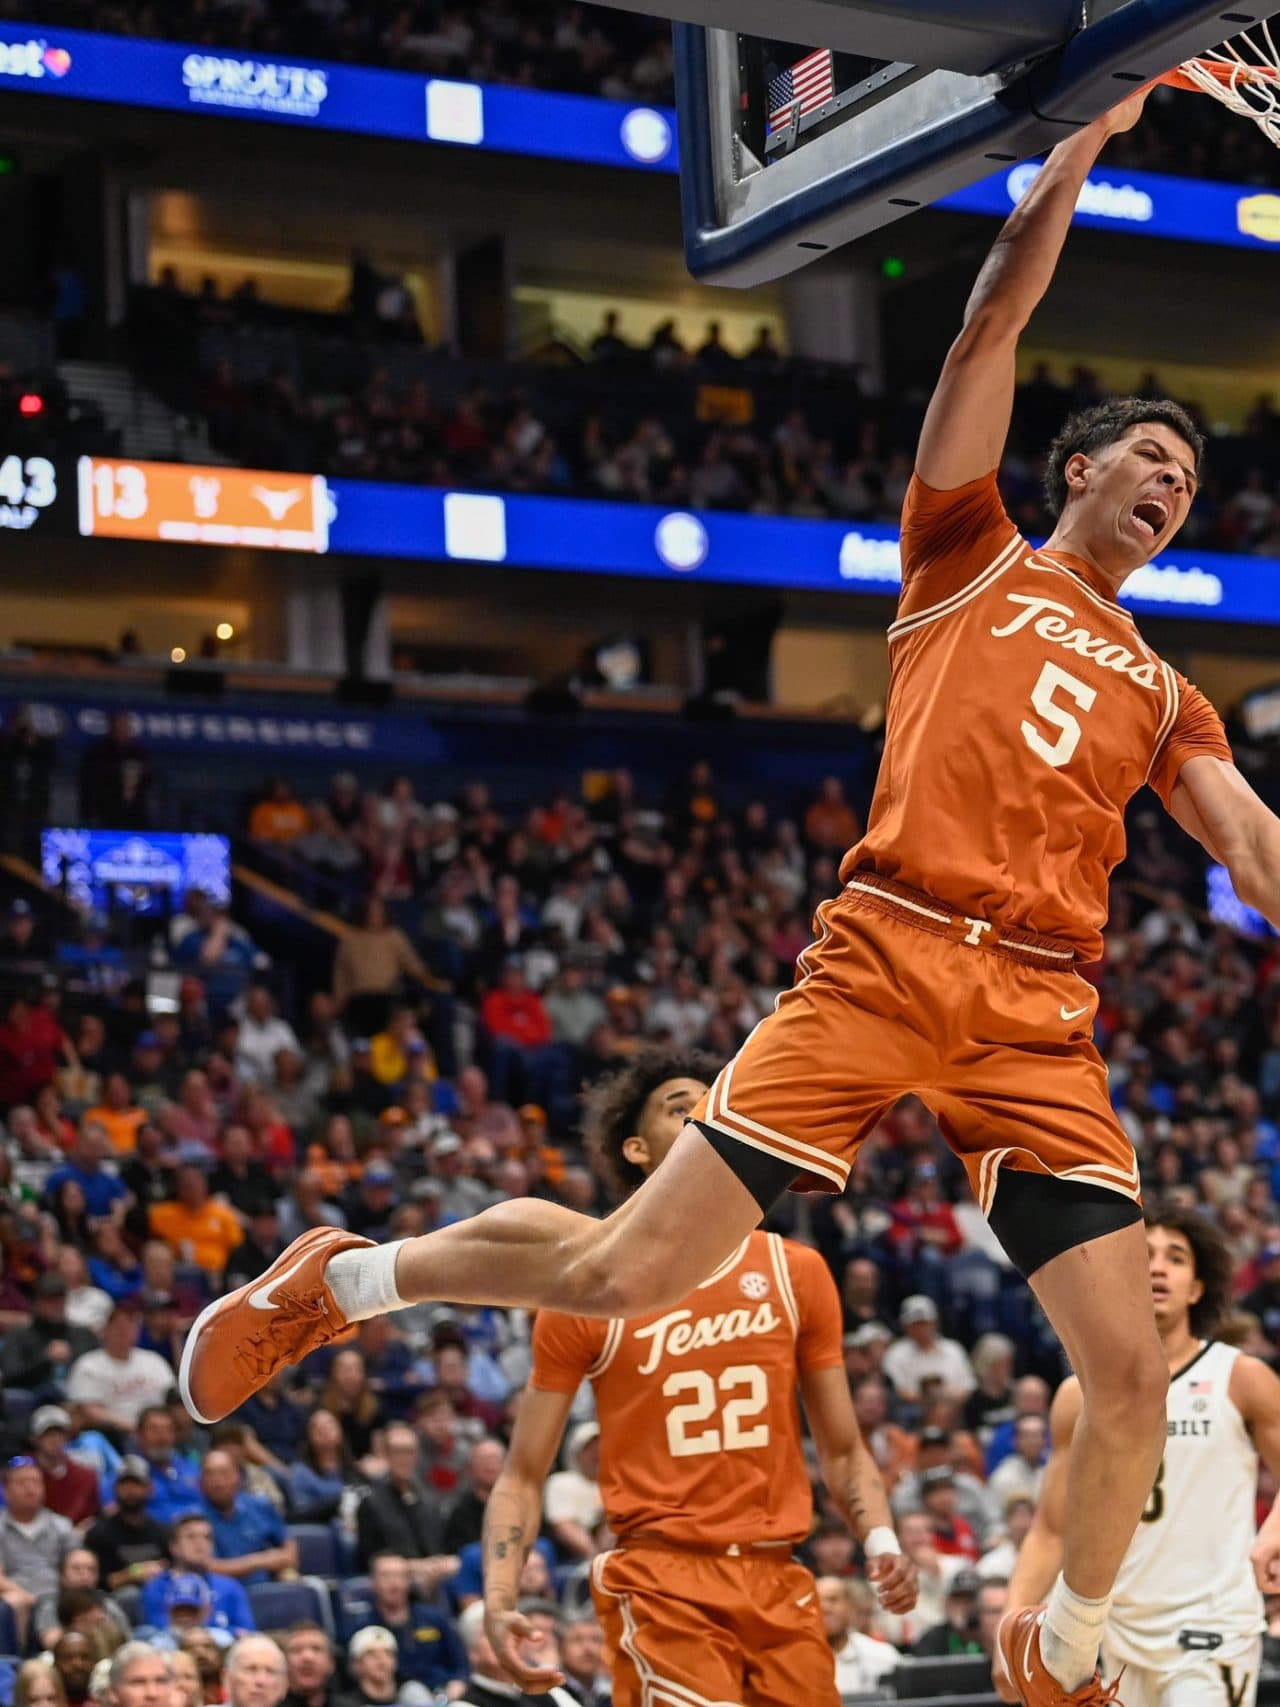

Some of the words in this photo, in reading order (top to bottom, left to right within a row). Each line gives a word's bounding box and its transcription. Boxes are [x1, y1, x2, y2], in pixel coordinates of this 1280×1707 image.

[182, 54, 328, 103] SPROUTS
[0, 455, 57, 507] 43
[94, 464, 148, 520] 13
[991, 593, 1161, 691] Texas
[1020, 660, 1098, 767] 5
[633, 1302, 782, 1375] Texas
[662, 1364, 769, 1457] 22
